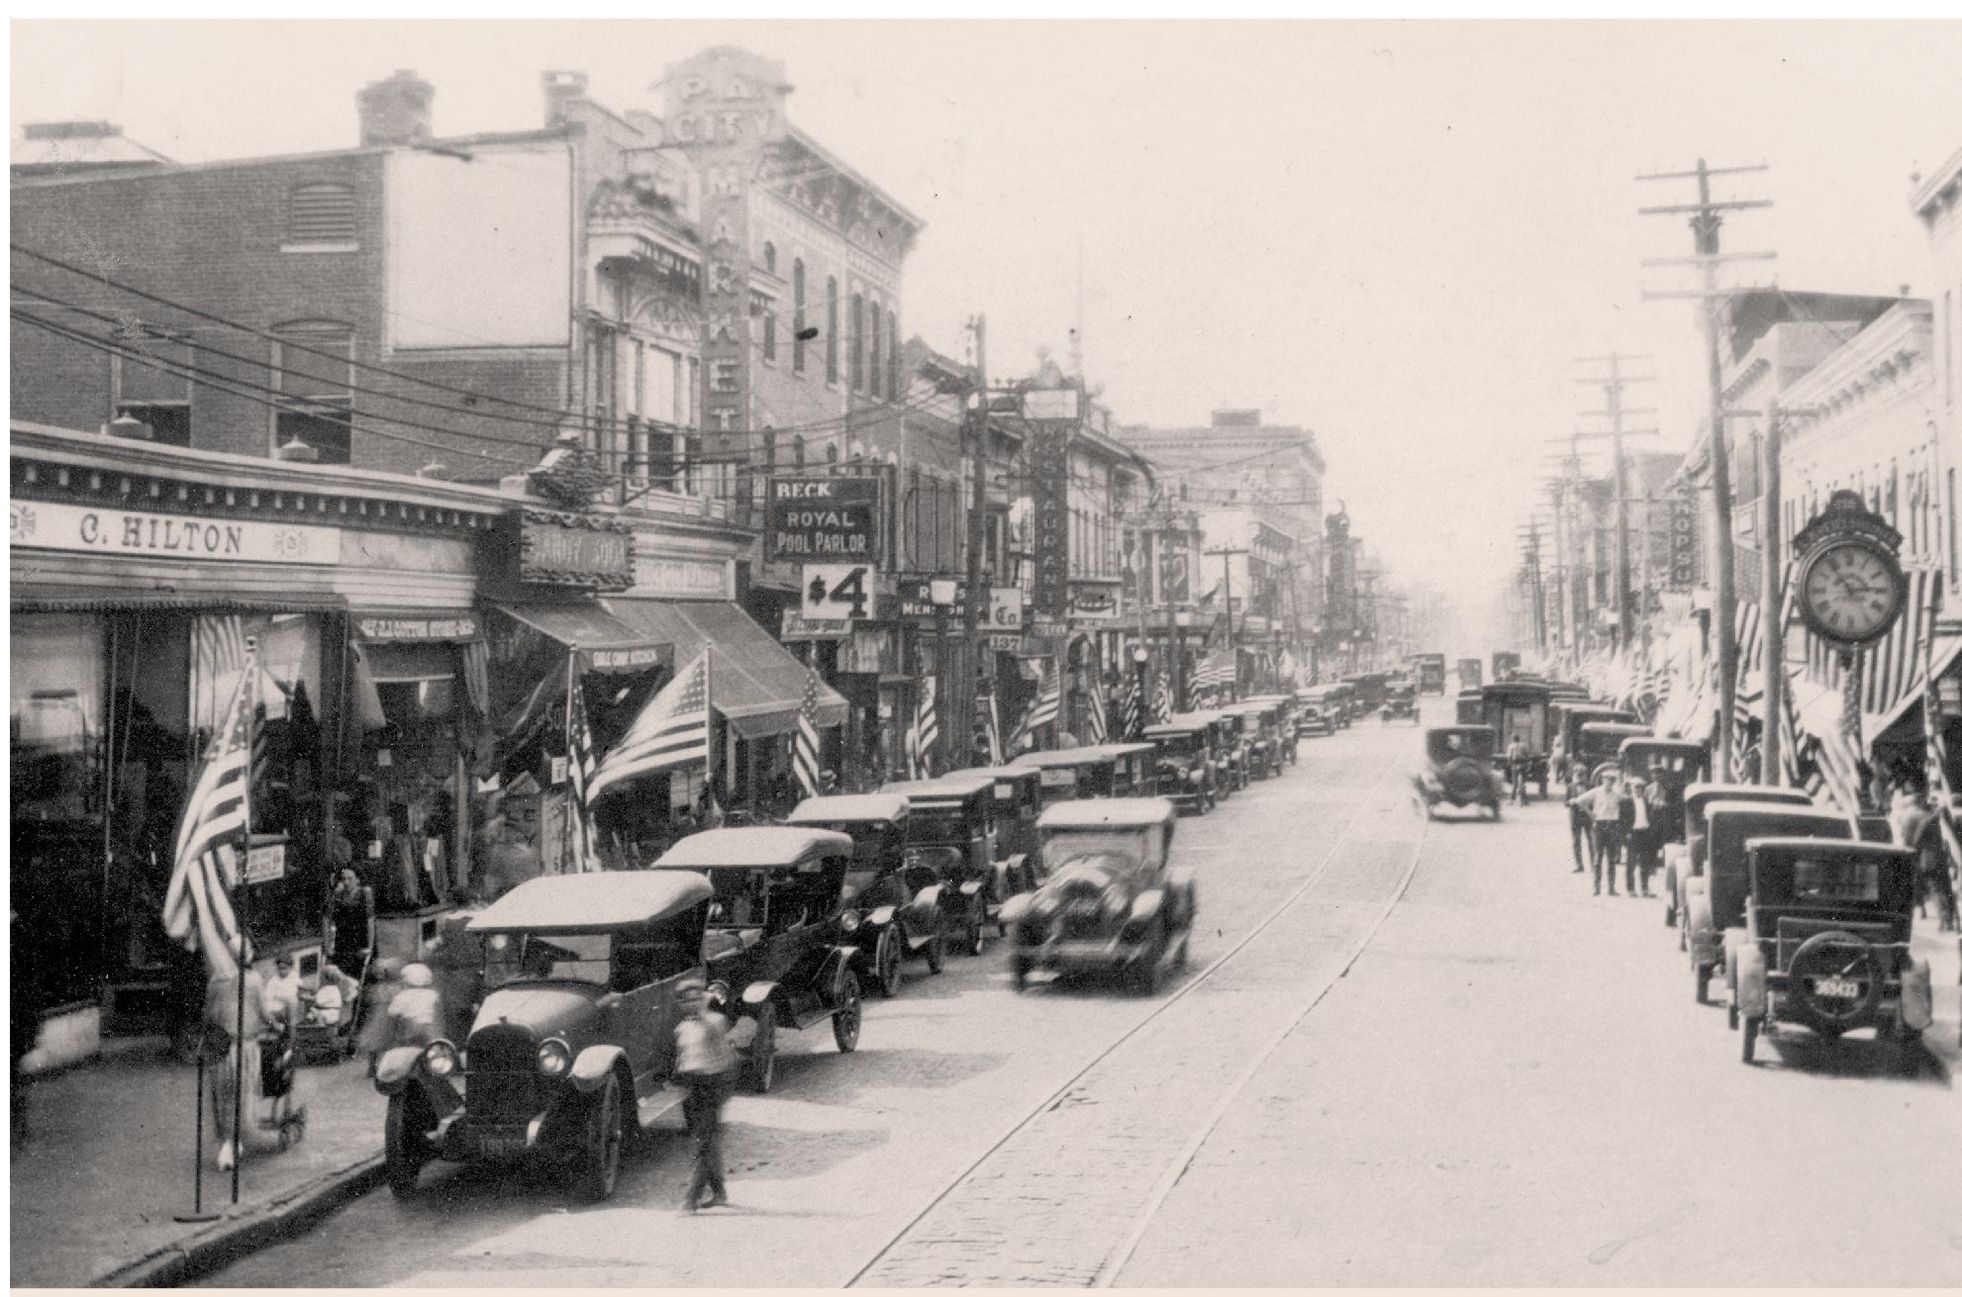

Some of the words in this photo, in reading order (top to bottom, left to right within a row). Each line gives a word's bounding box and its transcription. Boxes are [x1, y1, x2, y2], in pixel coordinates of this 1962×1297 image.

[708, 165, 741, 438] MARKET
[80, 513, 107, 544] C.
[122, 516, 242, 553] HILTON
[788, 511, 855, 527] ROYAL
[776, 532, 811, 553] POOL
[815, 531, 866, 553] PARLOR
[808, 568, 868, 618] $4
